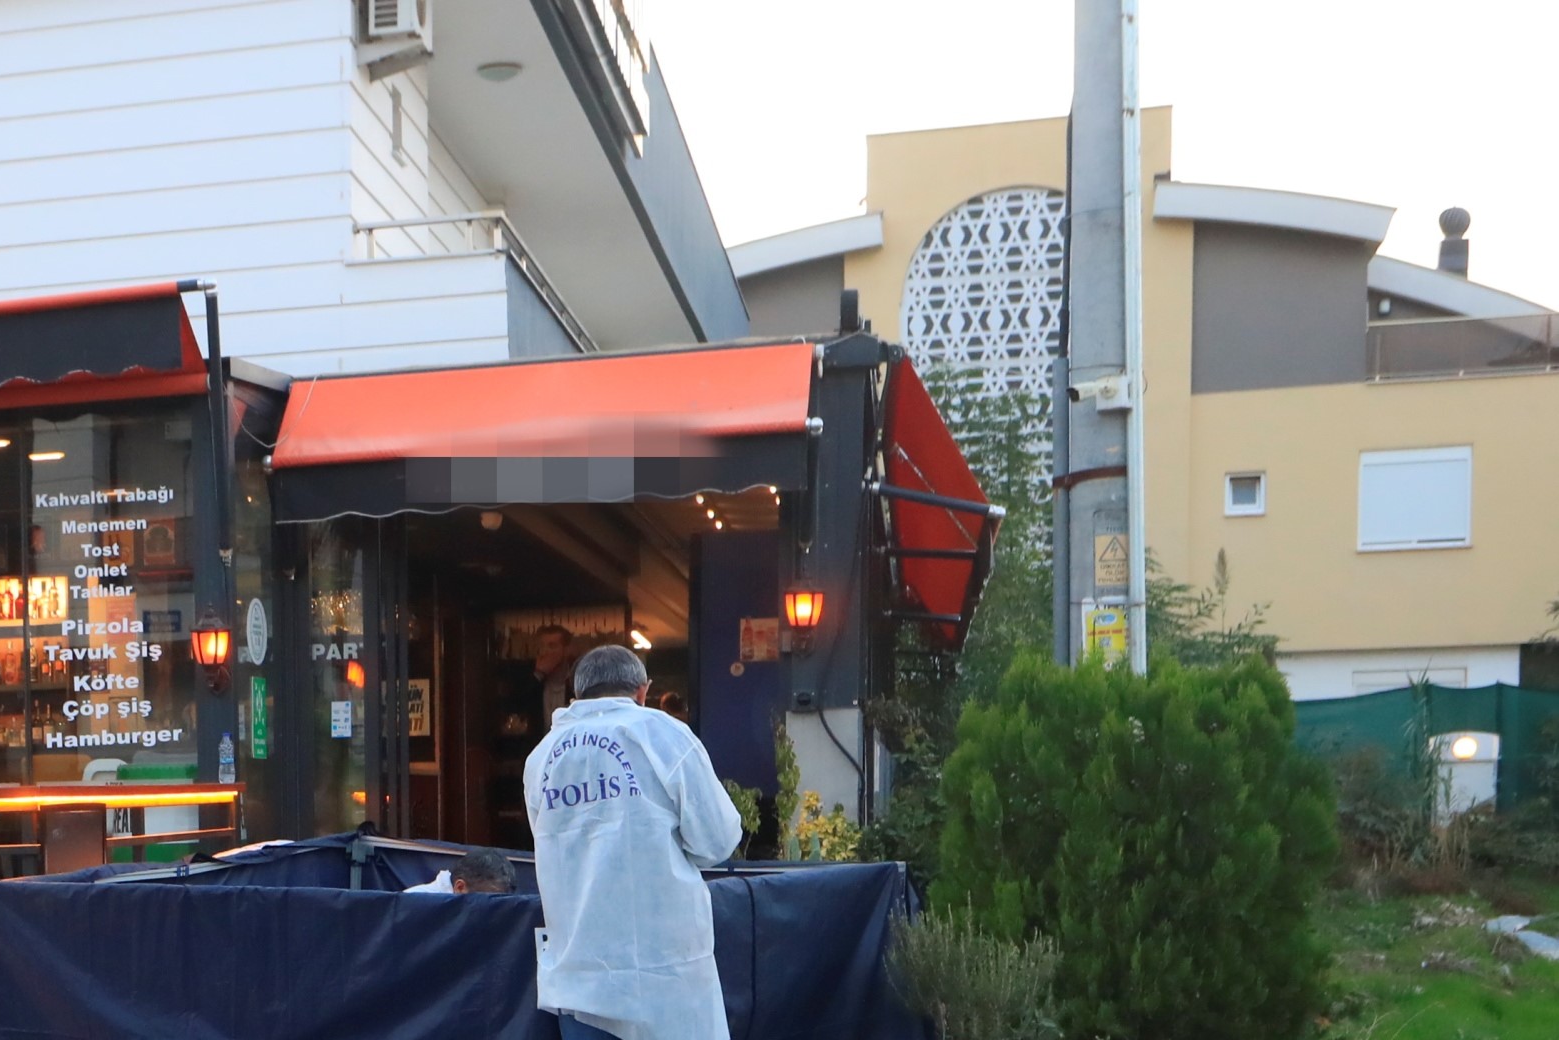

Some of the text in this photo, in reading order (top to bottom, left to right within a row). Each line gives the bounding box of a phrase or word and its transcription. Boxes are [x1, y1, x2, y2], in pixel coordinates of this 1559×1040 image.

[35, 485, 174, 508] Kahvaltı Tabağı
[62, 518, 147, 534] Menemen
[81, 543, 120, 557] Tost
[74, 563, 128, 578] Omlet
[70, 583, 133, 599] Tatlılar
[61, 618, 144, 635] Pirzola
[44, 641, 162, 662] Tavuk Şiş
[311, 643, 364, 660] PAR
[74, 674, 139, 692] Köfte
[63, 697, 152, 721] Çöp şiş
[46, 728, 182, 748] Hamburger
[545, 773, 621, 811] POLİS
